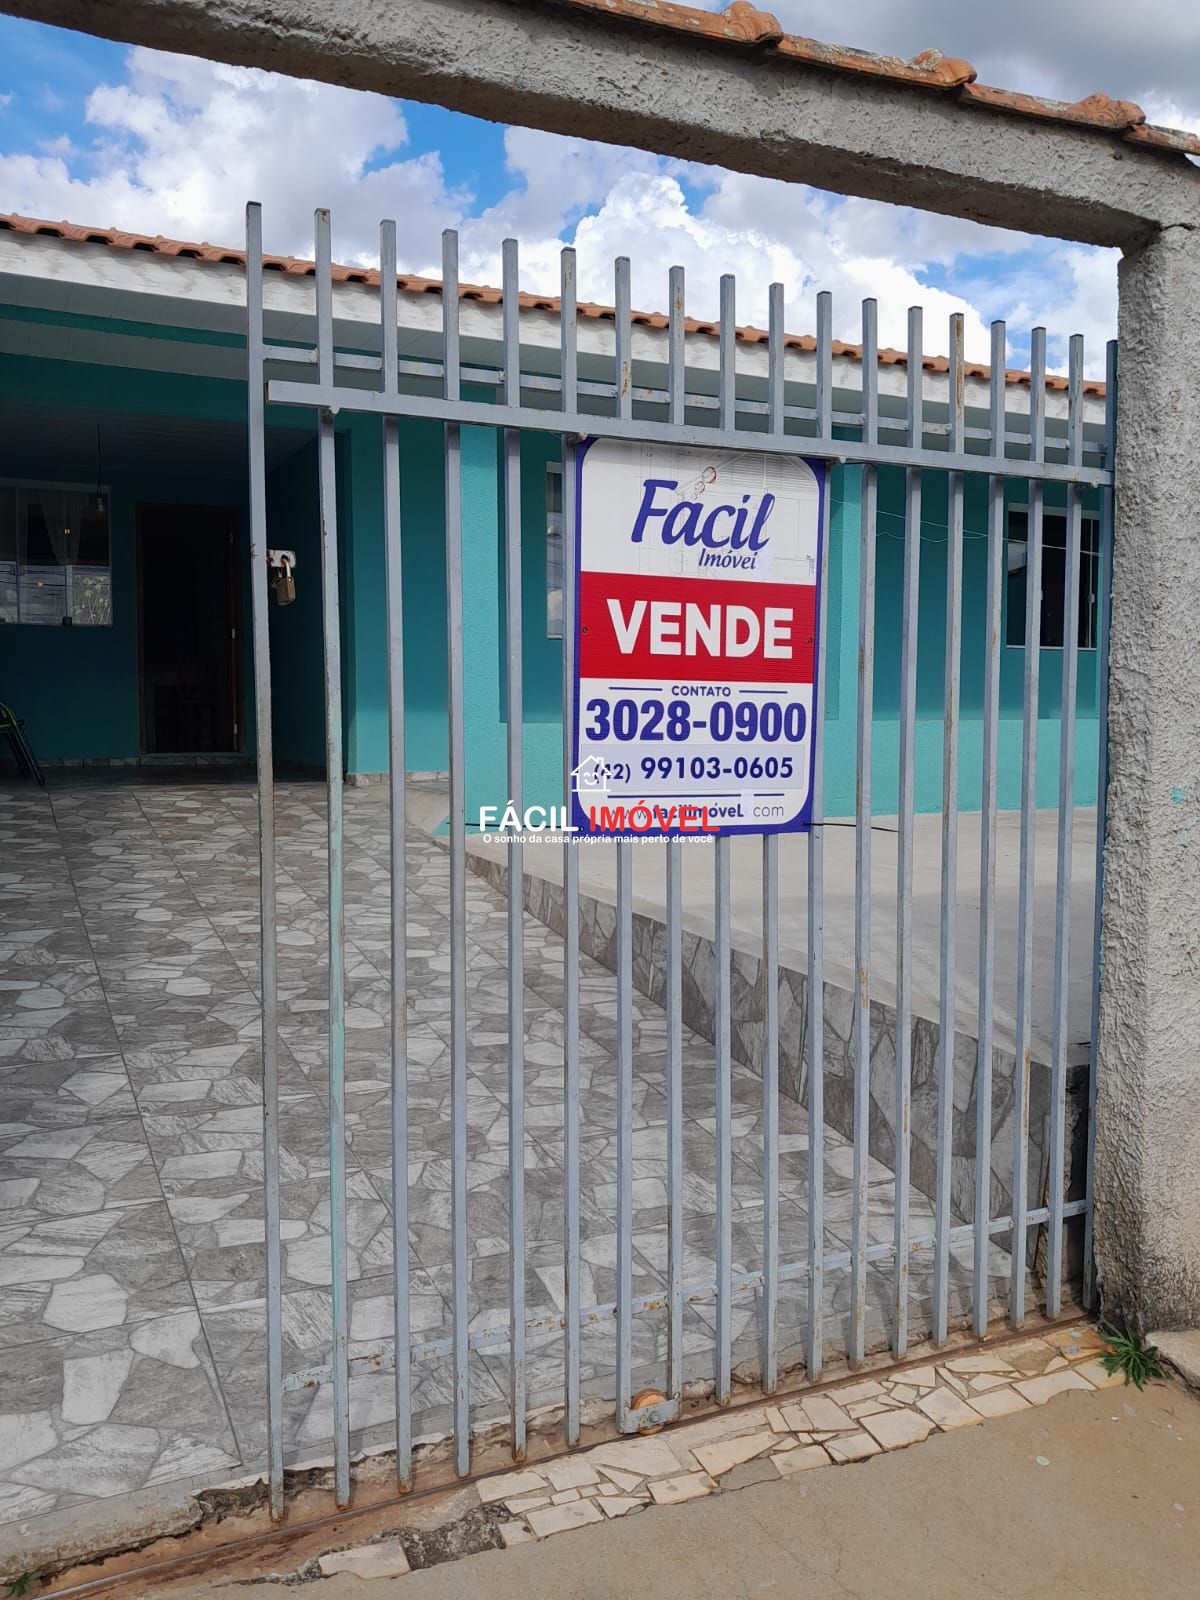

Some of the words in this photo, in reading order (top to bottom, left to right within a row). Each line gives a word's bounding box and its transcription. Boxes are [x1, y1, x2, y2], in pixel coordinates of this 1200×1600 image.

[606, 598, 794, 659] VENDE
[671, 685, 731, 697] CONTATO
[585, 698, 806, 742] 3028-0900
[640, 757, 793, 779] 99103-0605
